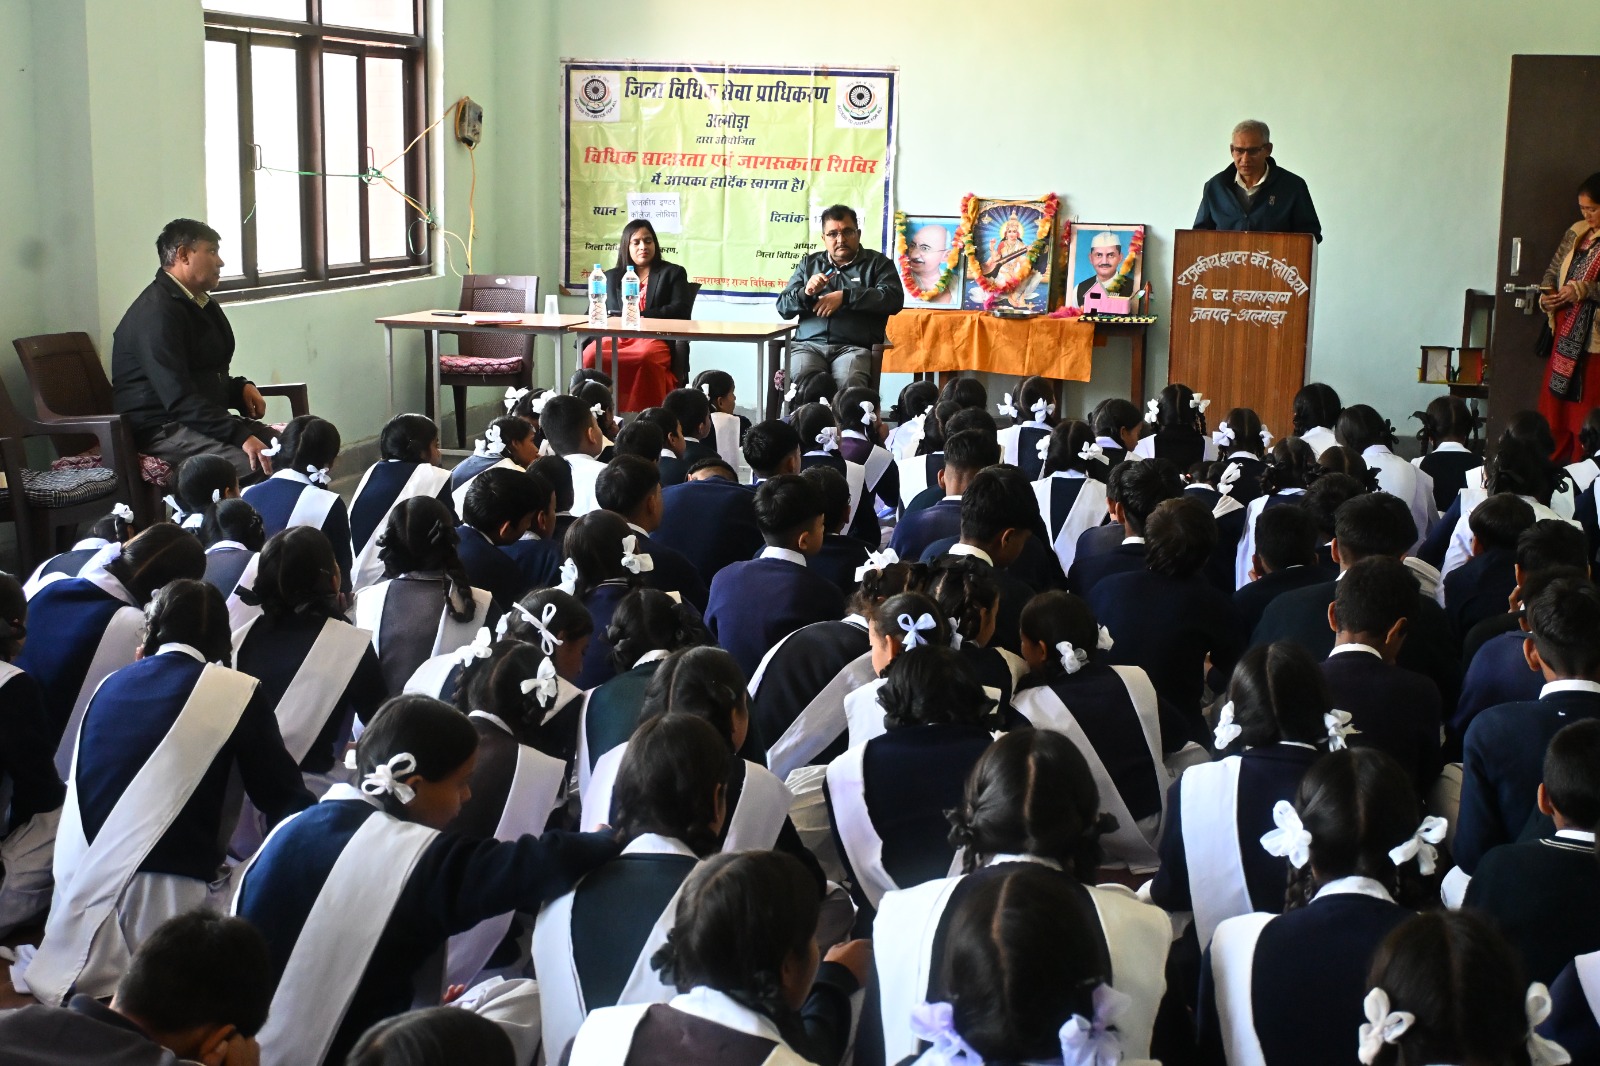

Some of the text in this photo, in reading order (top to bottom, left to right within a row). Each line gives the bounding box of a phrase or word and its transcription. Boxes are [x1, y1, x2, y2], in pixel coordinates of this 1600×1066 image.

[625, 76, 830, 104] जिला विधिक सेवा प्राधिकरण
[706, 112, 749, 133] अल्मोड़ा
[584, 146, 878, 174] विधिक साक्षरता एवं जागरूकता शिविर
[651, 173, 662, 185] में
[664, 175, 707, 187] आपका
[710, 173, 747, 190] हार्दिक
[751, 178, 788, 191] स्वागत
[632, 198, 656, 206] राजकीय
[593, 206, 617, 216] स्थान
[585, 243, 603, 251] जिला
[756, 251, 774, 259] जिला
[776, 251, 800, 259] विधिक
[732, 278, 748, 287] राज्य
[750, 277, 775, 288] विधिक
